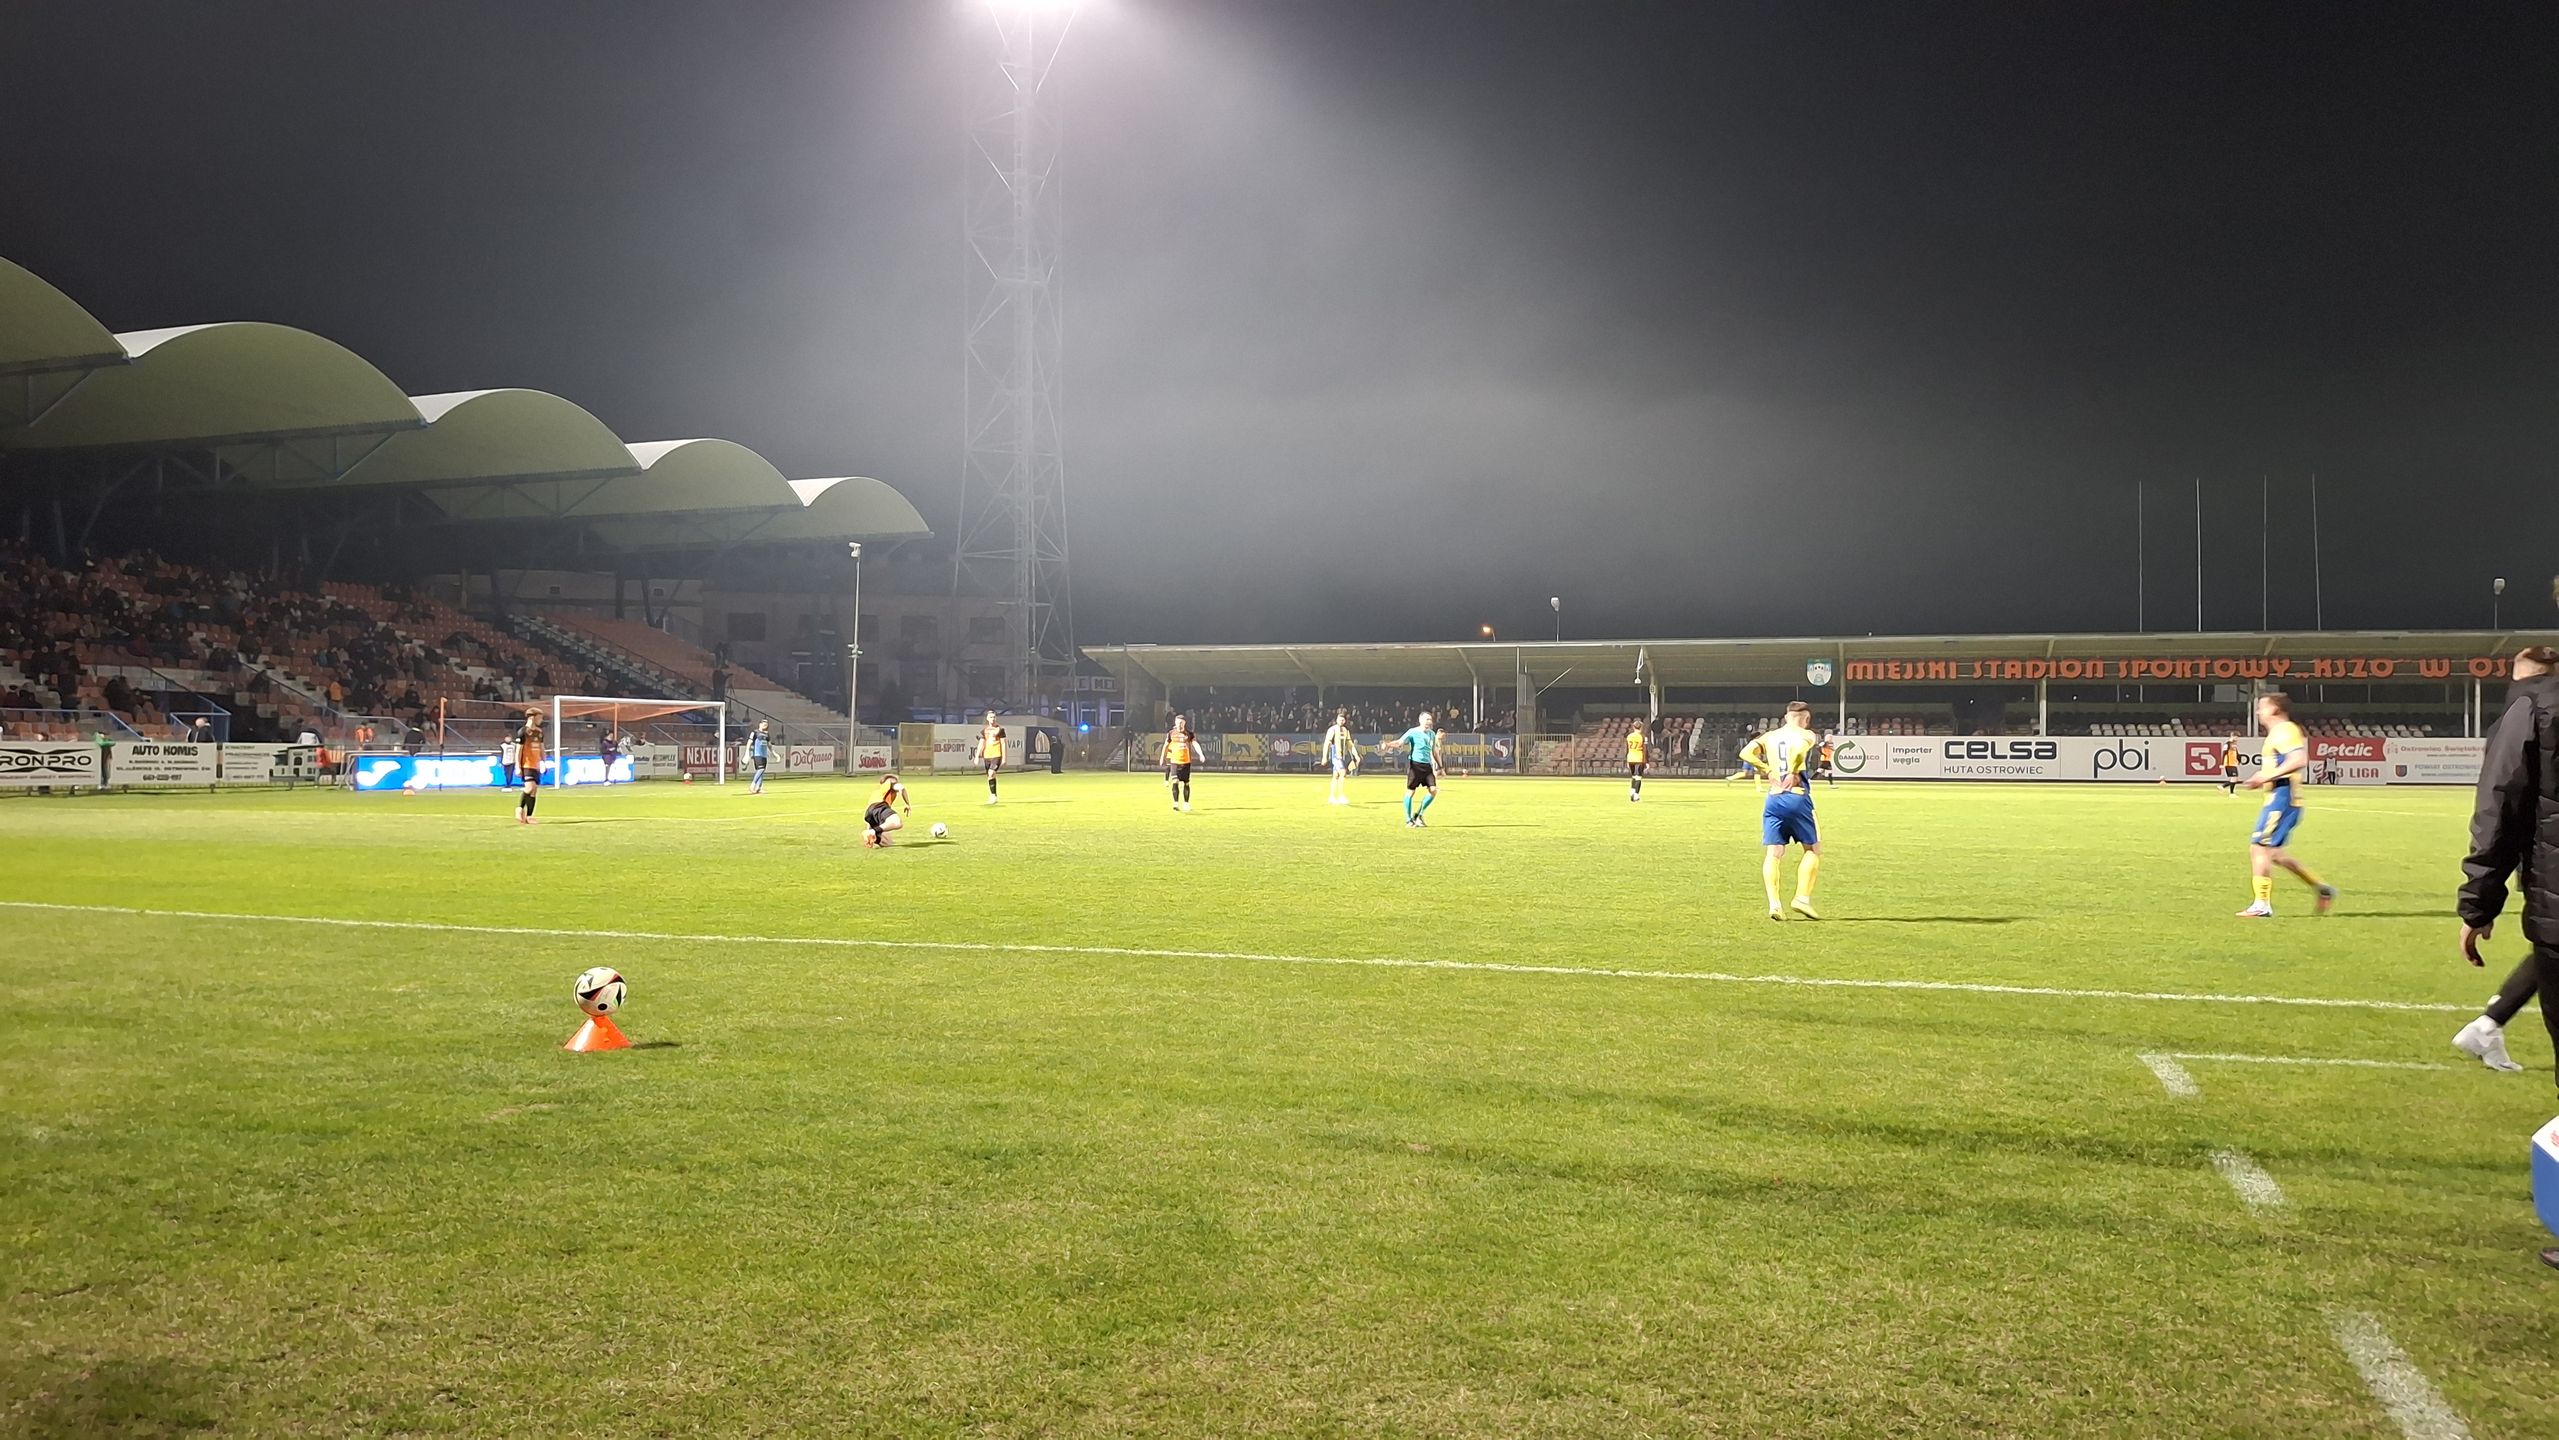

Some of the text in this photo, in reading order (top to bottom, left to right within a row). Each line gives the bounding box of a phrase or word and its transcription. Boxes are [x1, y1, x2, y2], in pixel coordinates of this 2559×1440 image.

[1846, 659, 1959, 680] MIEJSKI
[1973, 659, 2105, 679] STADION
[2119, 658, 2291, 679] SPORTOWY
[2419, 658, 2449, 679] W
[2468, 658, 2510, 679] OS
[132, 745, 160, 756] AUTO
[686, 747, 733, 765] NEXTEO
[1892, 746, 1933, 755] Importer
[2317, 743, 2374, 757] Betclic
[1892, 756, 1921, 765] węgla
[2093, 739, 2150, 779] pbi
[1944, 765, 2044, 775] HUTA OSTROWIEC
[2349, 767, 2380, 779] LIGA
